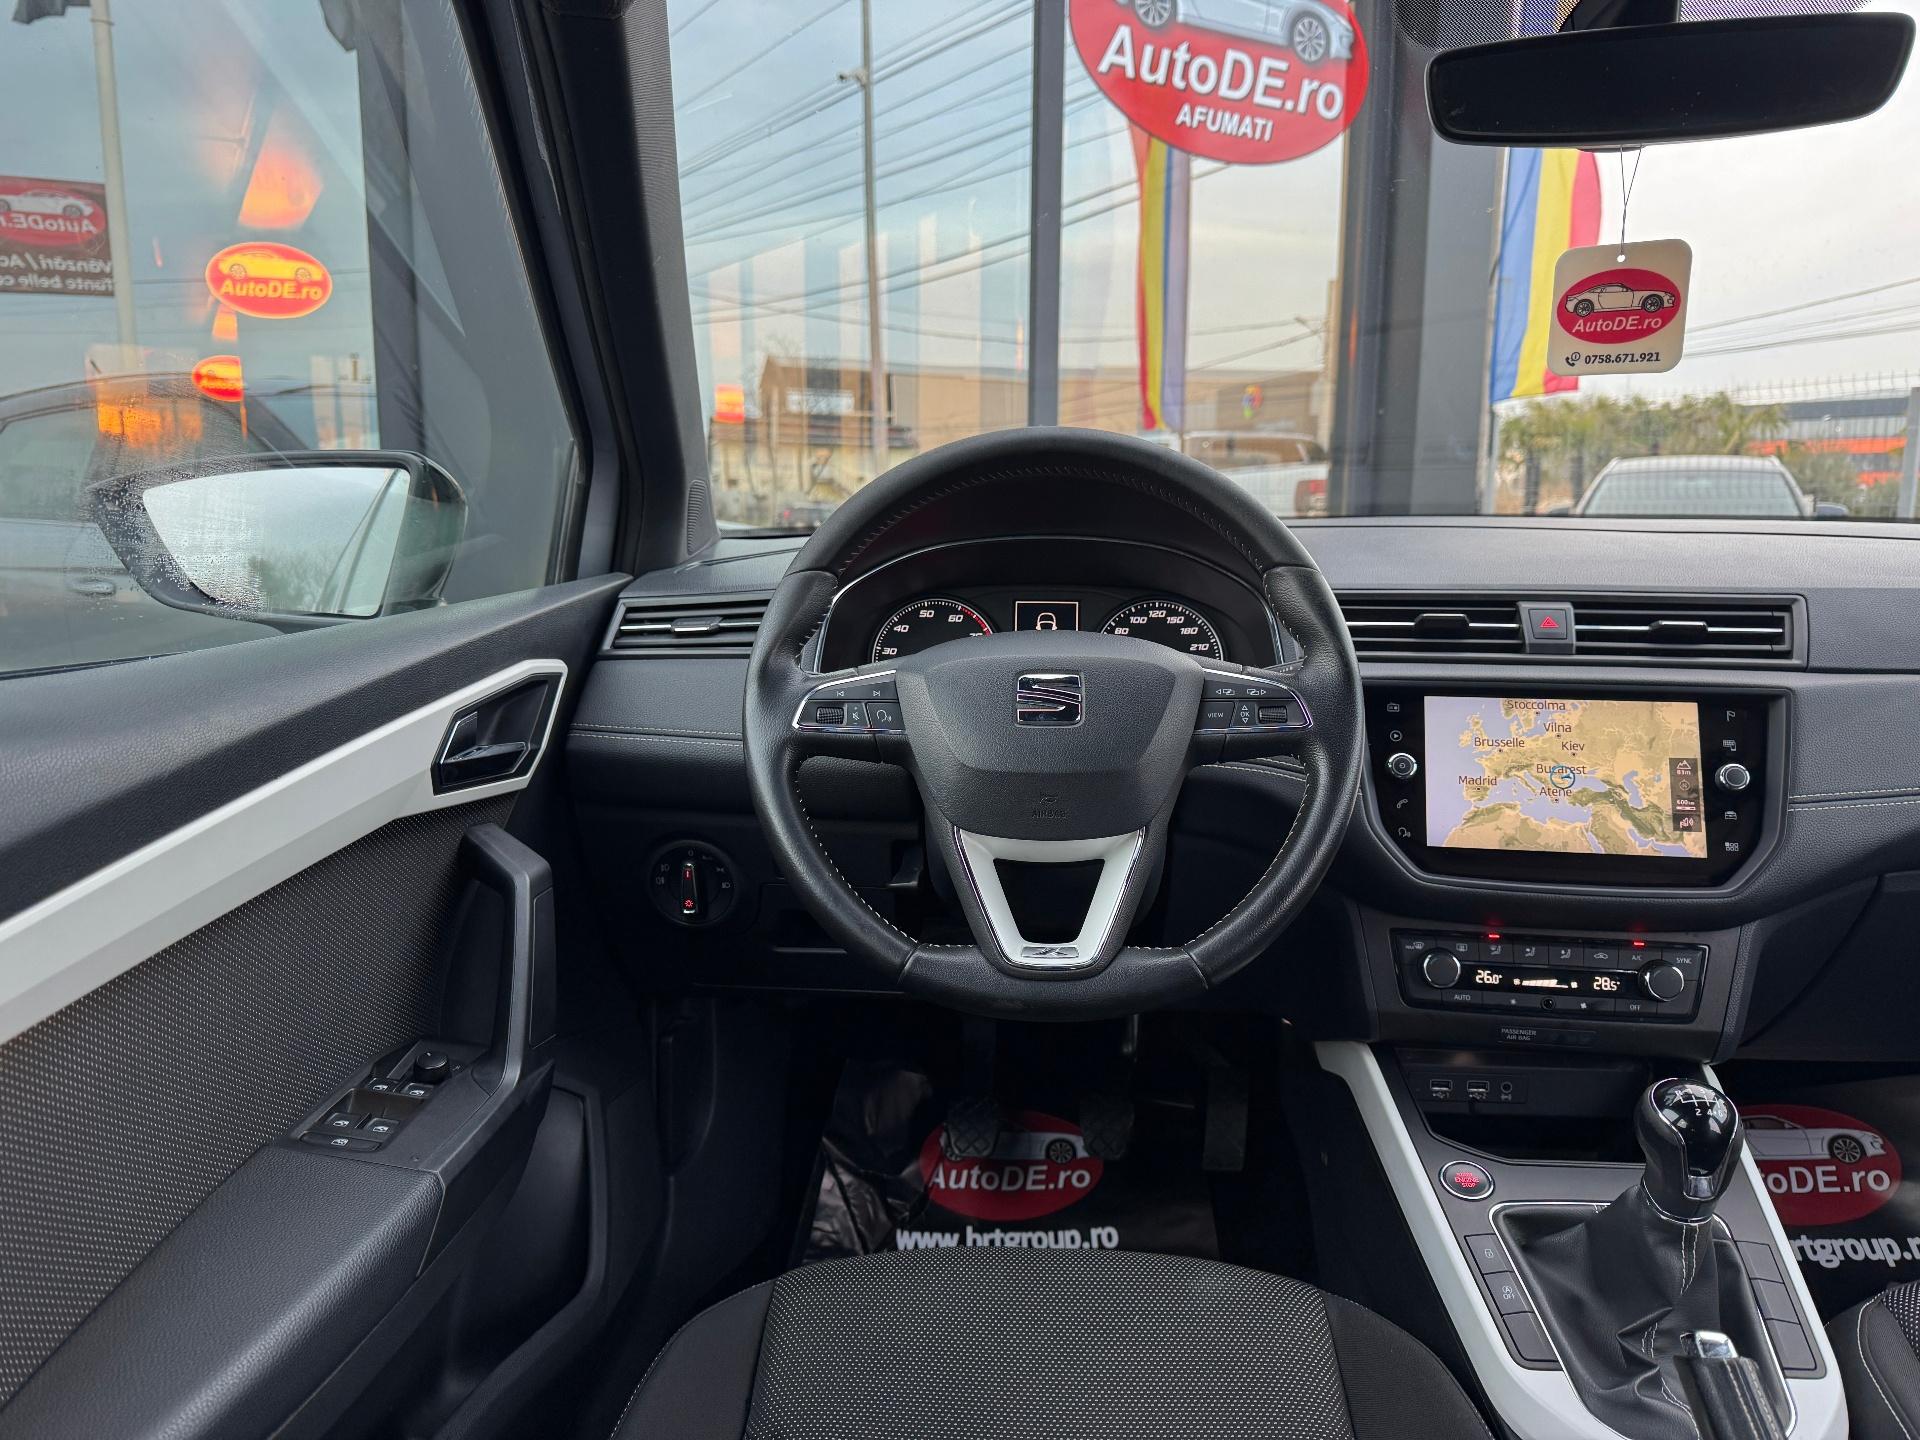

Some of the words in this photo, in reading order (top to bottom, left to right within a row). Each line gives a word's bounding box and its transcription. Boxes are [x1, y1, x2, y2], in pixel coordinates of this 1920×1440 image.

[1097, 24, 1345, 120] AutoDE.ro
[1175, 103, 1274, 142] AFUMATI
[220, 279, 323, 301] AutoDE.ro
[1572, 315, 1662, 333] AutoDE.ro
[1584, 351, 1661, 364] 0758.671.921
[919, 609, 934, 618] 50
[948, 614, 963, 622] 60
[1148, 610, 1166, 618] 120
[1129, 616, 1147, 624] 100
[1166, 616, 1184, 624] 150
[893, 624, 909, 633] 40
[1114, 627, 1129, 635] 80
[1180, 627, 1198, 635] 180
[882, 647, 897, 655] 30
[1189, 643, 1209, 651] 210
[1507, 699, 1566, 710] Stoccolma
[1543, 722, 1572, 733] Vilna
[1474, 737, 1525, 748] Brusselle
[1561, 741, 1585, 751] Kiev
[1536, 763, 1587, 775] Bucarest
[1458, 775, 1498, 786] Madrid
[1539, 786, 1572, 797] Atene
[929, 1161, 1091, 1191] AutoDE.ro
[1760, 1165, 1891, 1194] oDE.ro
